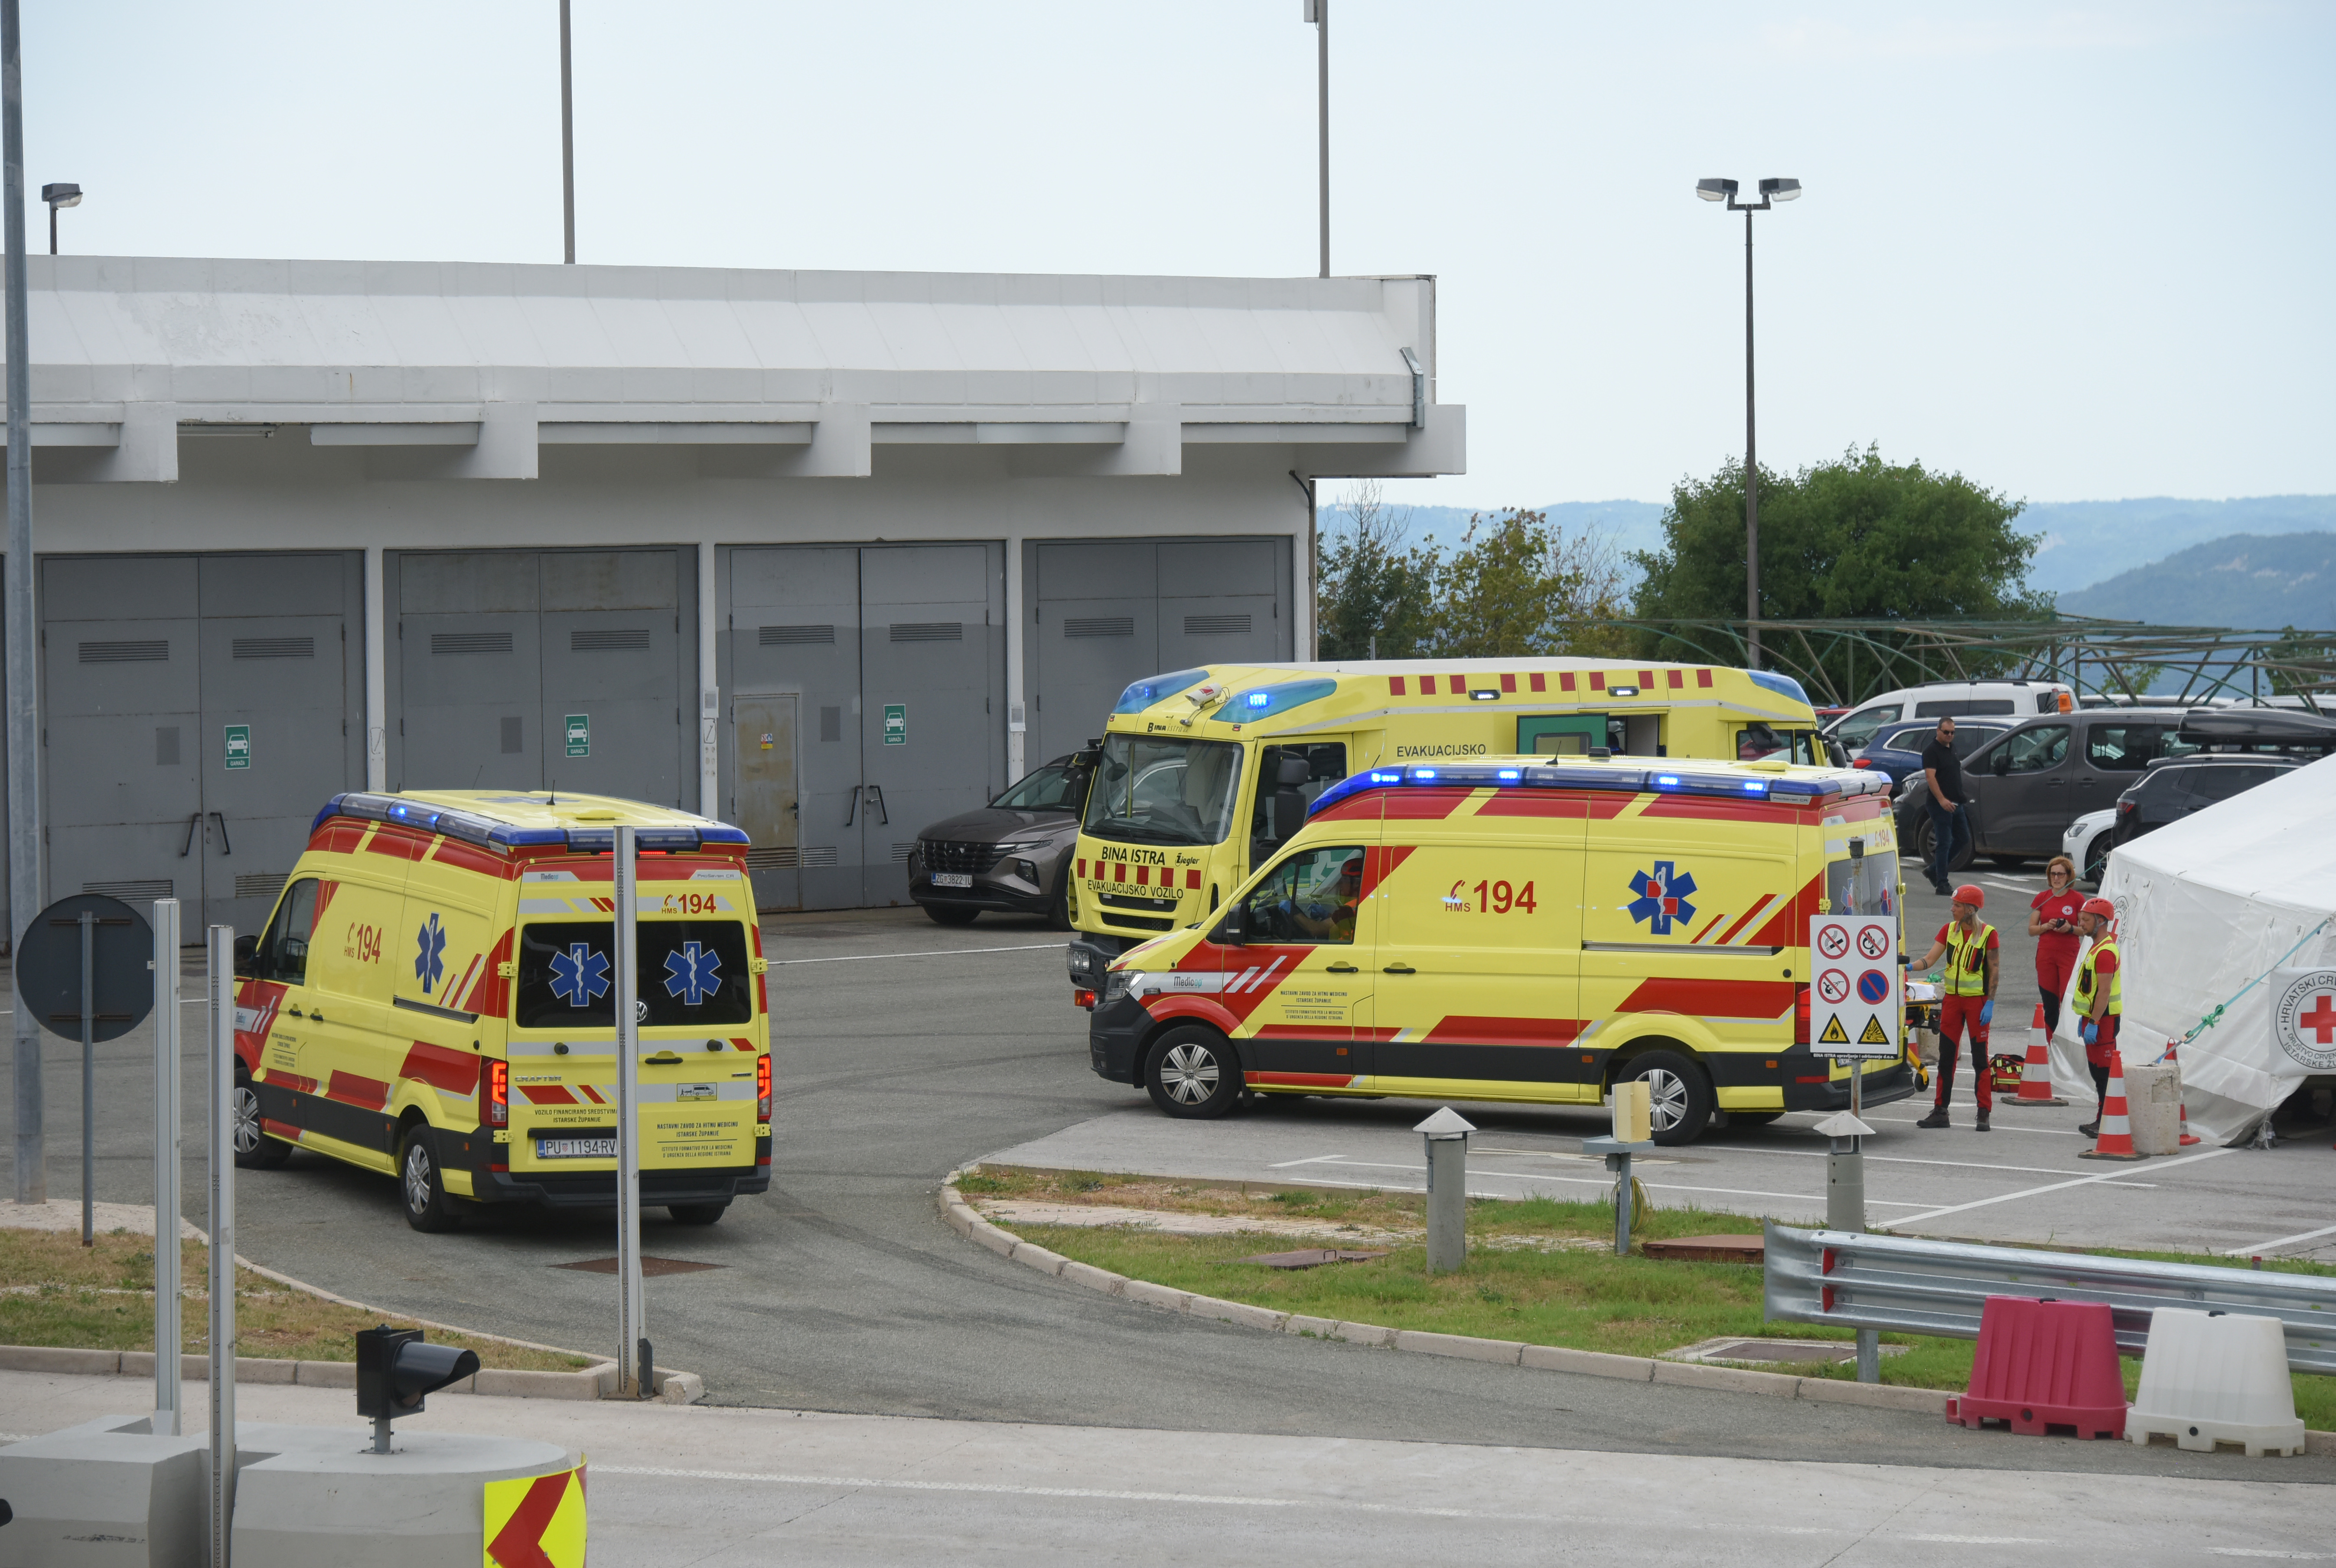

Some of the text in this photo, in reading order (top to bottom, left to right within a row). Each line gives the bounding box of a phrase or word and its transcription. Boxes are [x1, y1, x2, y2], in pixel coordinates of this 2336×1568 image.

[1147, 722, 1166, 732] BINA
[1397, 744, 1486, 757] EVAKUACIJSKO
[1879, 828, 1890, 847] 194
[1101, 846, 1165, 865] BINA ISTRA
[936, 875, 944, 883] ZG
[1088, 879, 1183, 899] EVAKUACIJSKO VOZILO
[1445, 880, 1537, 914] HMS 194
[678, 894, 717, 914] 194
[344, 924, 382, 964] HMS 194
[1174, 976, 1202, 989] Medicop
[2281, 976, 2336, 1023] HRVATSKI CR
[2284, 1042, 2324, 1067] ISTARSKE
[2287, 1033, 2313, 1057] DRUŠTVO
[546, 1141, 561, 1154] PU
